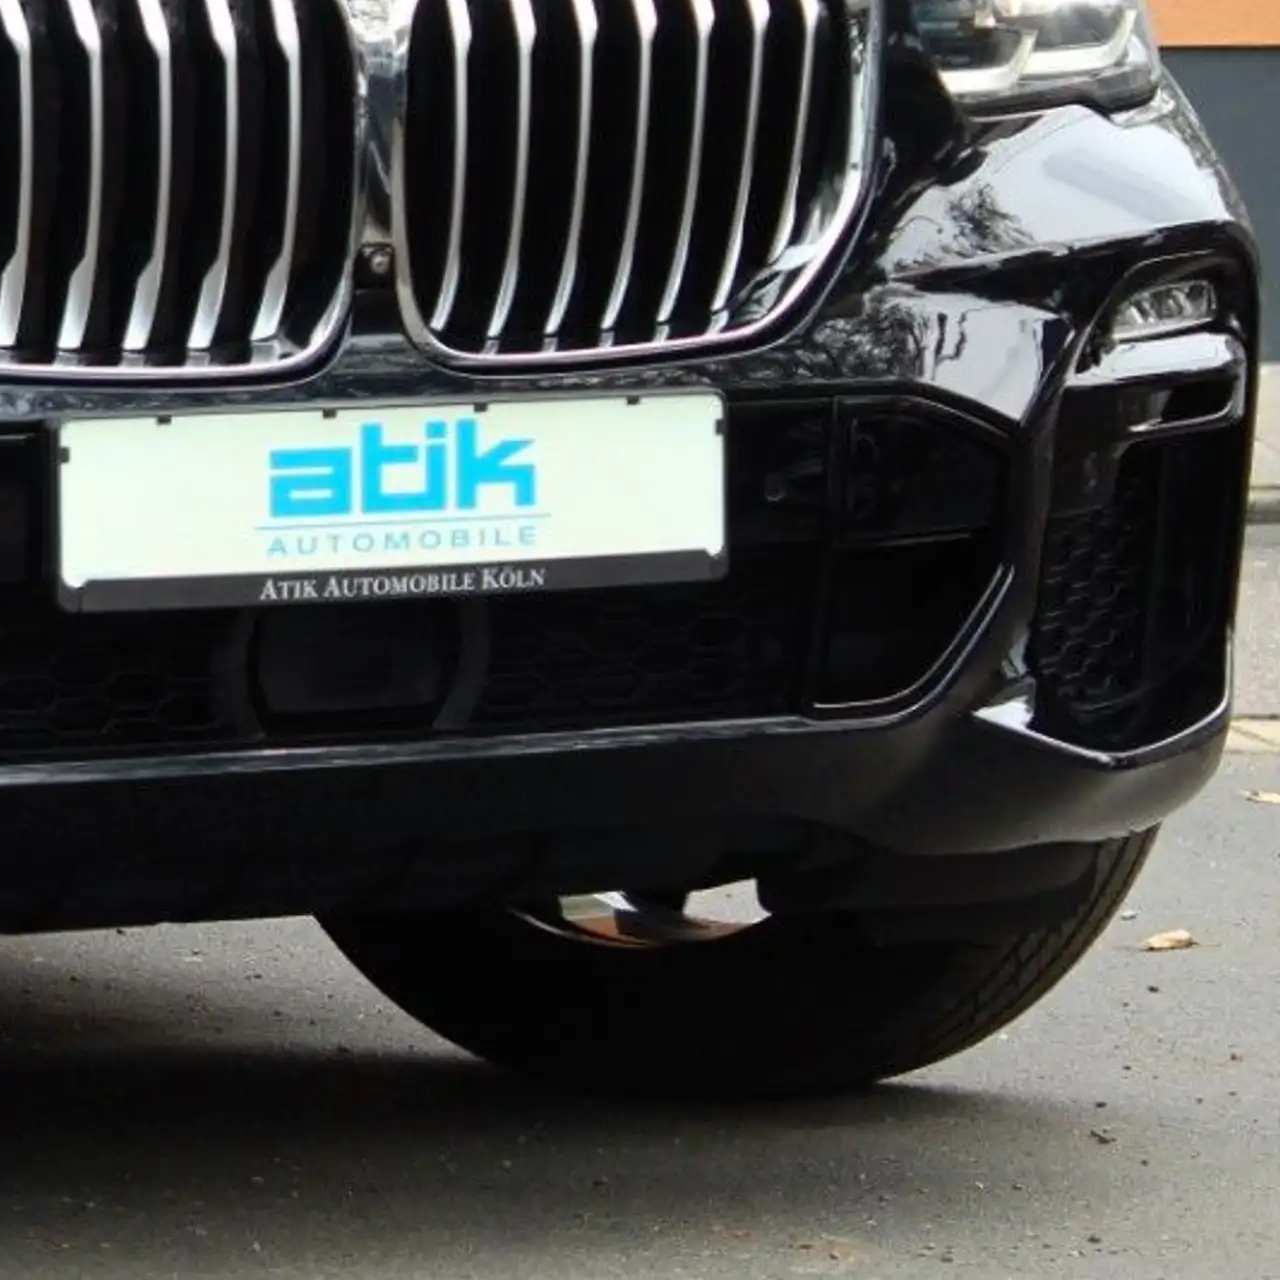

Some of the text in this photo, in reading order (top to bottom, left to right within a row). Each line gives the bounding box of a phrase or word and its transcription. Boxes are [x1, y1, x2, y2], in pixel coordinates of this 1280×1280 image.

[269, 418, 537, 518] atik
[268, 526, 536, 556] AUTOMOBILE
[260, 577, 319, 600] ATIK
[323, 571, 475, 598] AUTOMOBILE
